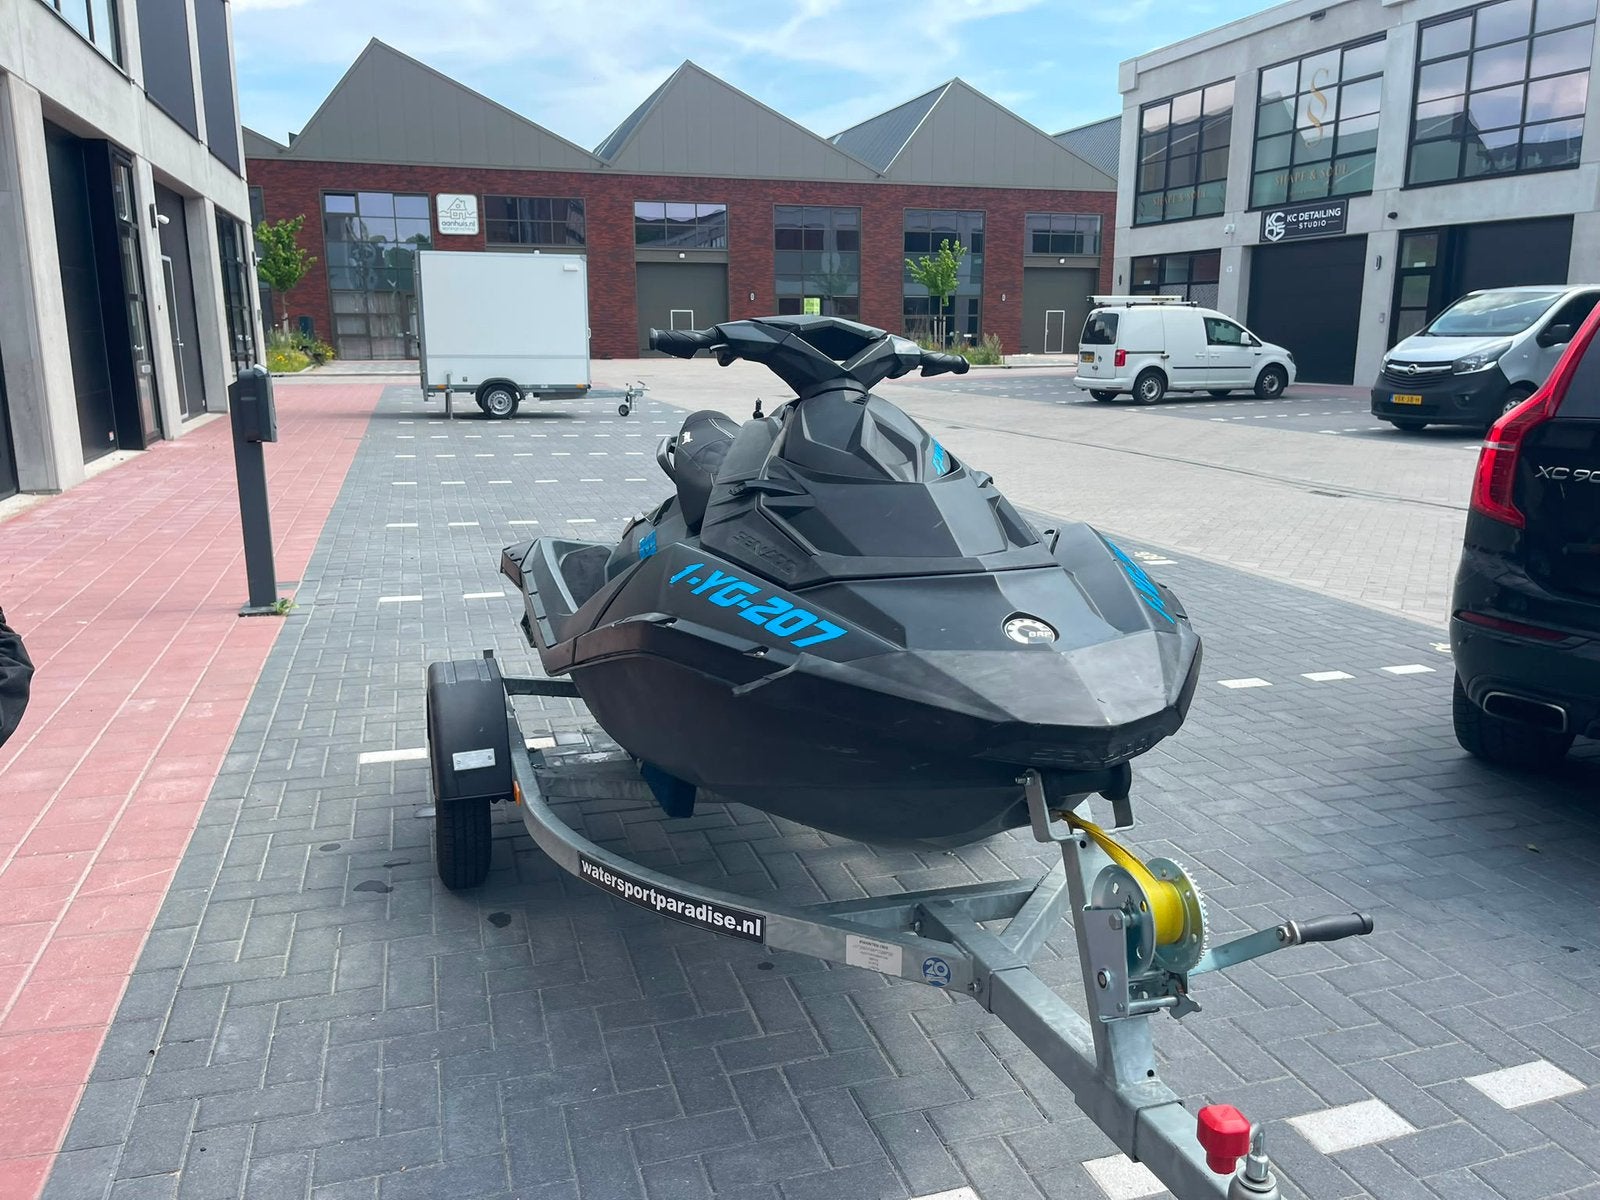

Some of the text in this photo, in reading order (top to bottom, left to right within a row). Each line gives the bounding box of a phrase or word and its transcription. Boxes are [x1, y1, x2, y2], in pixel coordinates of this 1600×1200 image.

[1287, 208, 1341, 222] KC DETAILING
[441, 220, 476, 228] aanhuis.nl
[1299, 220, 1327, 229] STUDIO
[669, 563, 848, 648] 1-YG-207
[581, 859, 761, 937] watersportparadise.nl
[925, 959, 949, 977] 20
